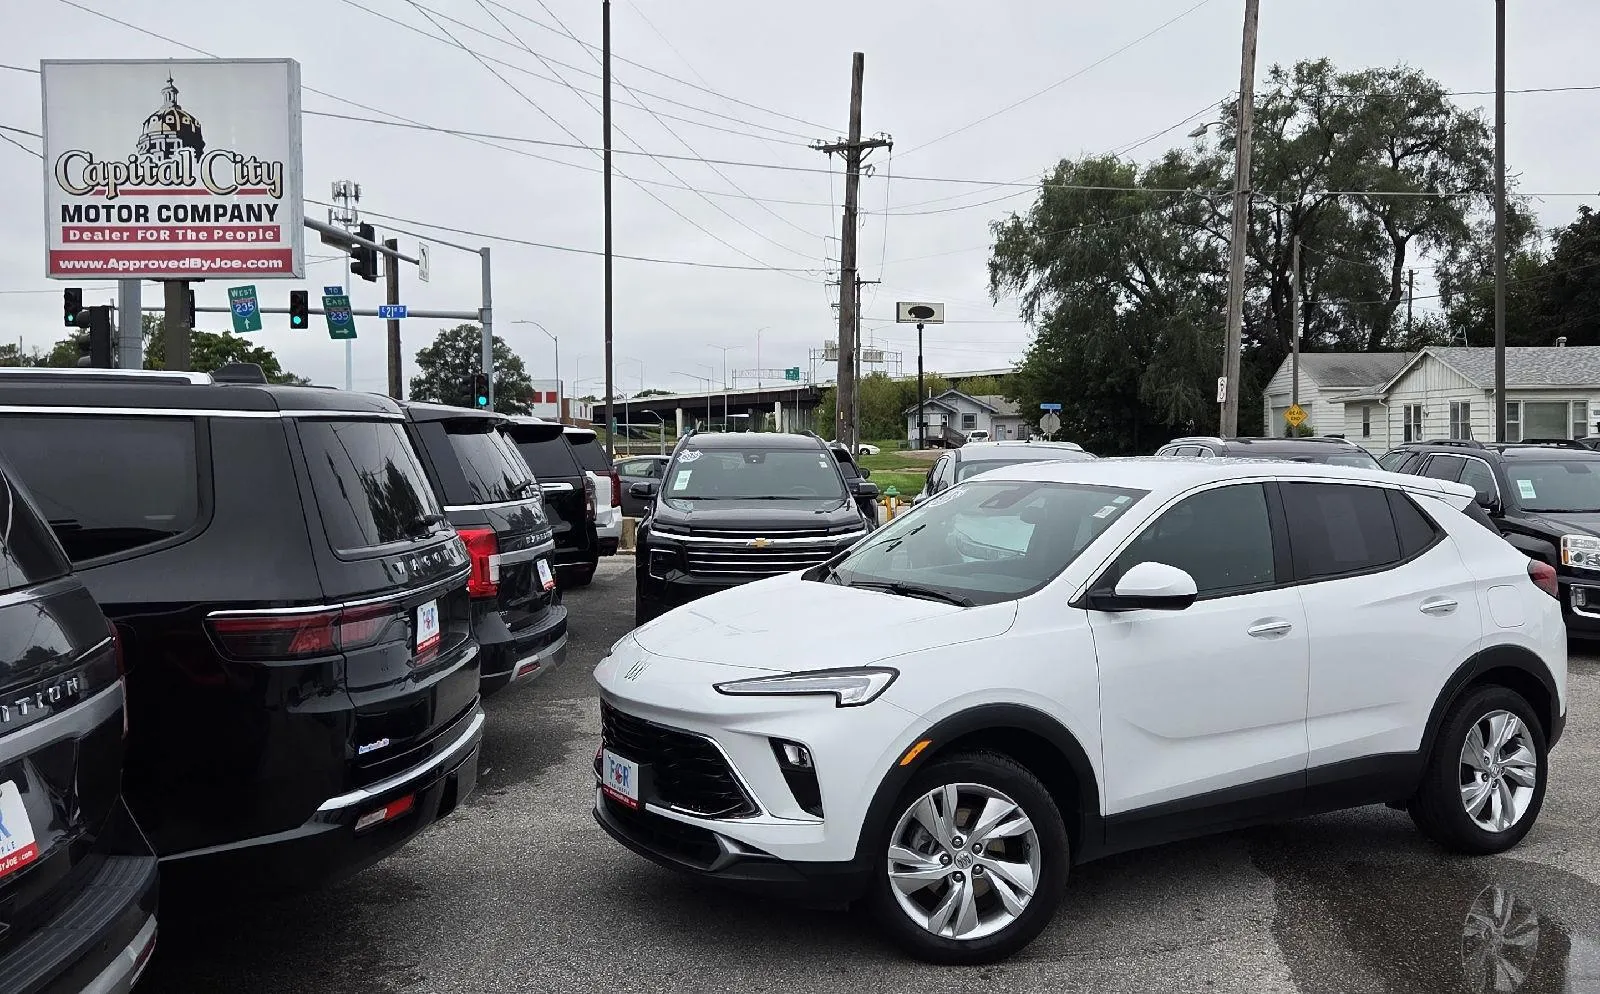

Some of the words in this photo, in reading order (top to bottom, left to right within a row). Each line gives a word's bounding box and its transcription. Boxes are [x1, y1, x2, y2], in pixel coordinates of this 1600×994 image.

[55, 150, 196, 200] Capital
[200, 149, 284, 199] City
[61, 204, 150, 223] MOTOR
[157, 203, 279, 222] COMPANY
[69, 229, 130, 241] Dealer
[137, 229, 170, 241] FOR
[177, 229, 208, 240] The
[213, 228, 275, 243] People
[59, 257, 283, 271] www.ApprovedByJoe.com
[235, 302, 255, 313] 235
[331, 311, 349, 321] 235
